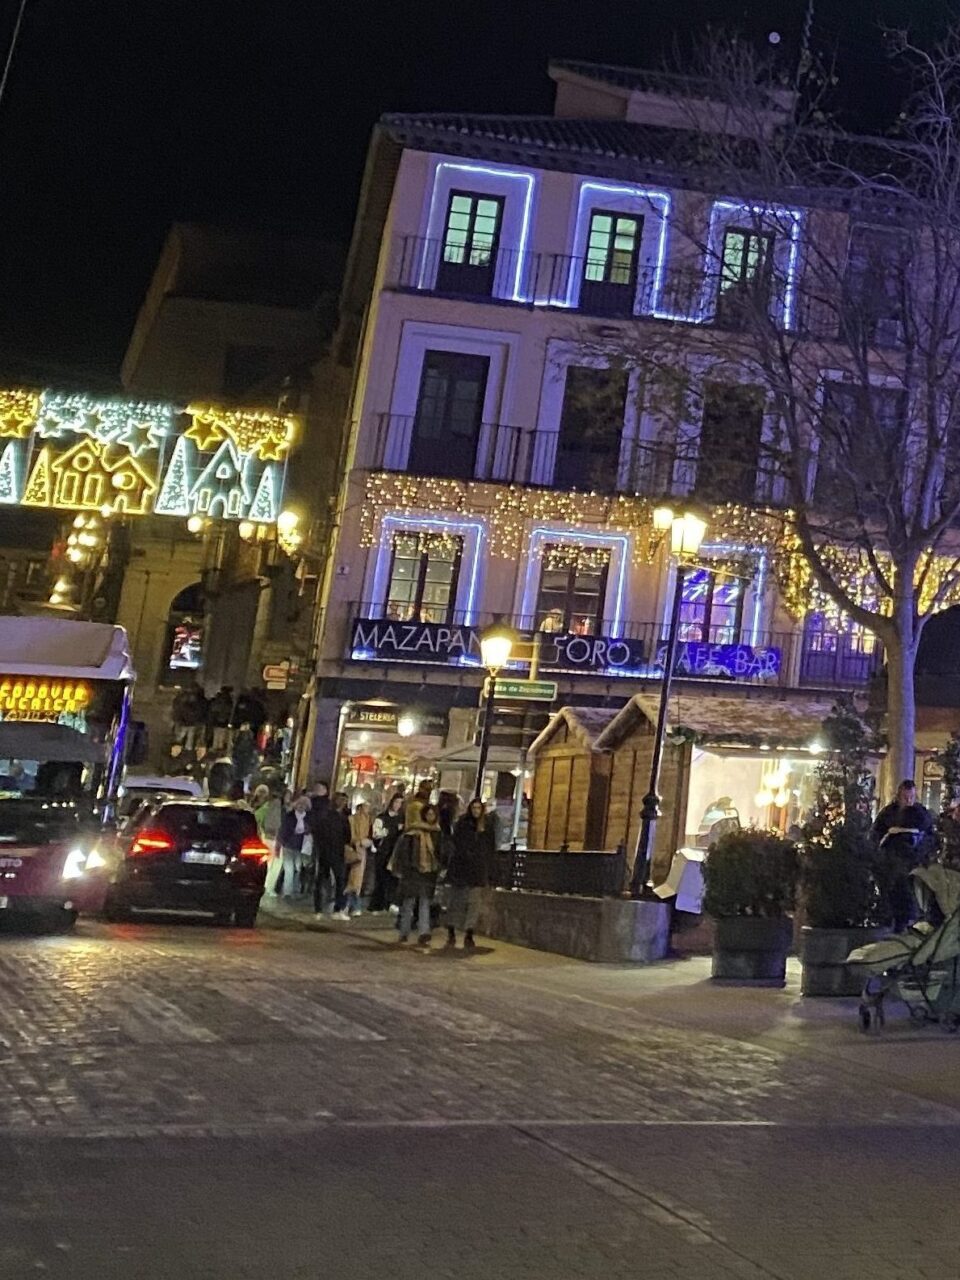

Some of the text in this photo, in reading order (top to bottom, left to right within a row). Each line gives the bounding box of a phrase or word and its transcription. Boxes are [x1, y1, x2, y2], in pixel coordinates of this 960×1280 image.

[553, 635, 631, 666] FORO
[735, 645, 778, 674] BAR
[350, 711, 396, 722] PSTELERIA
